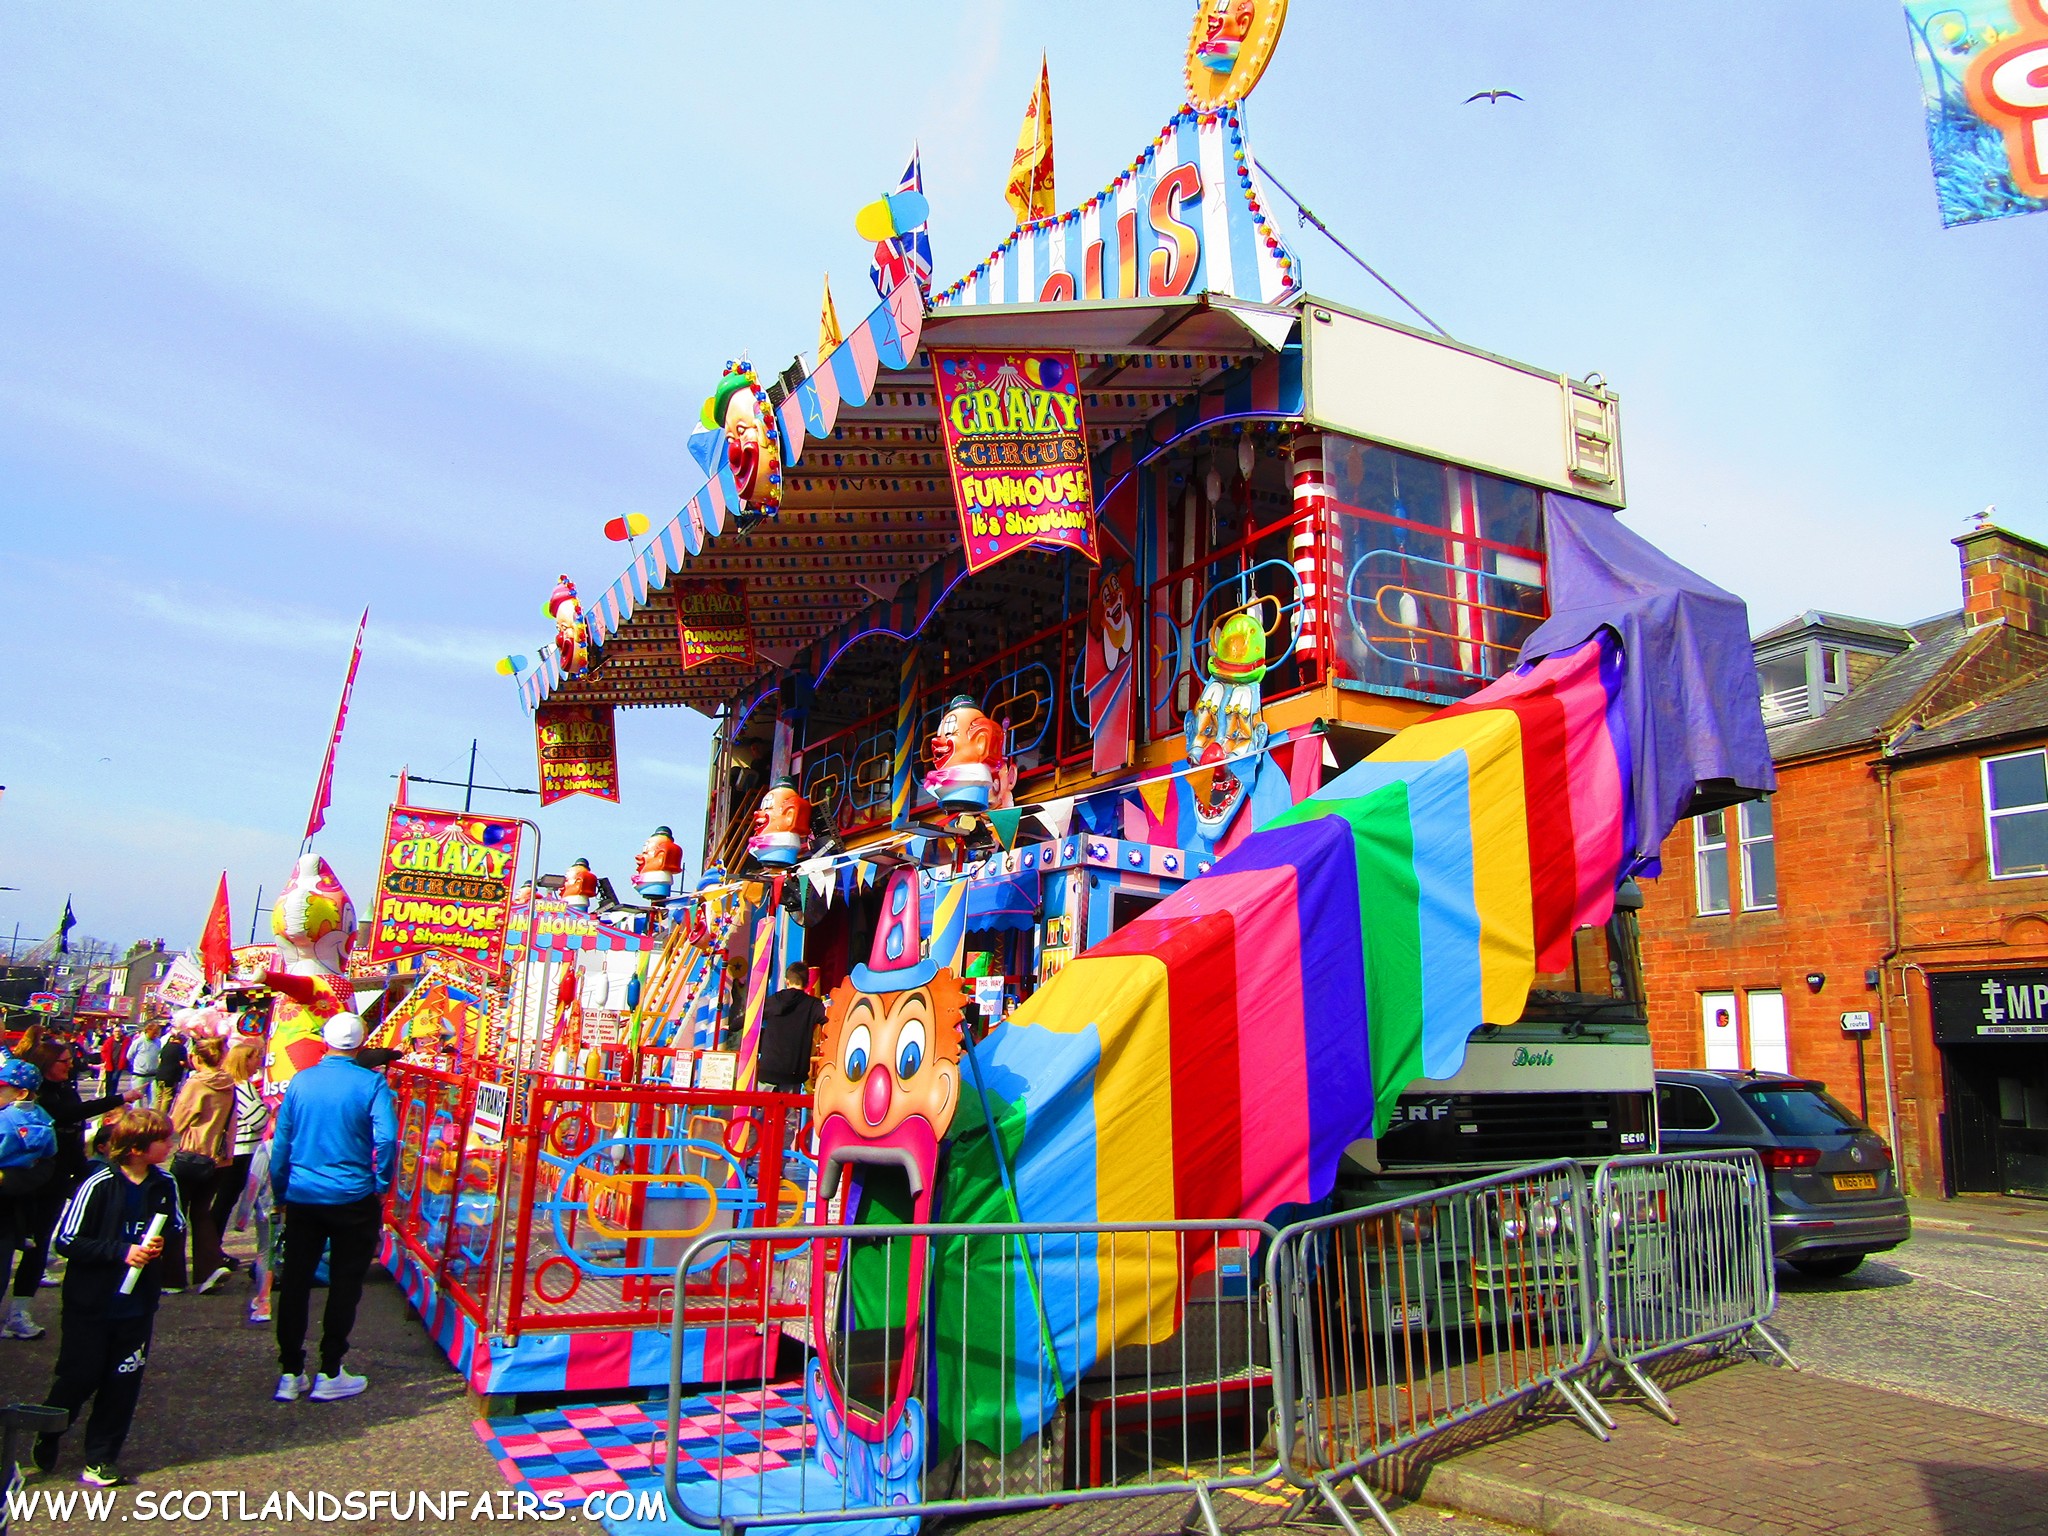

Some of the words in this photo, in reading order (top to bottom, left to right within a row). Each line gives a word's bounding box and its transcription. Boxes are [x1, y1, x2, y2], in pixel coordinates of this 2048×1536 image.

[949, 387, 1080, 435] CRAZY
[969, 440, 1079, 465] CIRCUS
[961, 470, 1088, 509] FUNHOUSE
[972, 511, 1001, 537] It's
[682, 594, 743, 613] CRAZY
[684, 628, 747, 642] FUNHOUSE
[541, 721, 611, 744] CRAZY
[543, 760, 612, 777] FUNHOUSE
[389, 838, 512, 879] CRAZY
[398, 875, 497, 899] CIRCUS
[382, 898, 499, 931] FUNHOUSE
[536, 900, 567, 912] RAZY
[381, 926, 408, 944] It's
[412, 927, 490, 950] Showtime
[538, 916, 599, 936] HOUSE
[1047, 915, 1071, 946] IT'S
[990, 980, 1002, 988] WAY
[1512, 1046, 1554, 1066] Doris
[477, 1085, 506, 1118] ENTRANCE
[1621, 1132, 1645, 1144] EC10
